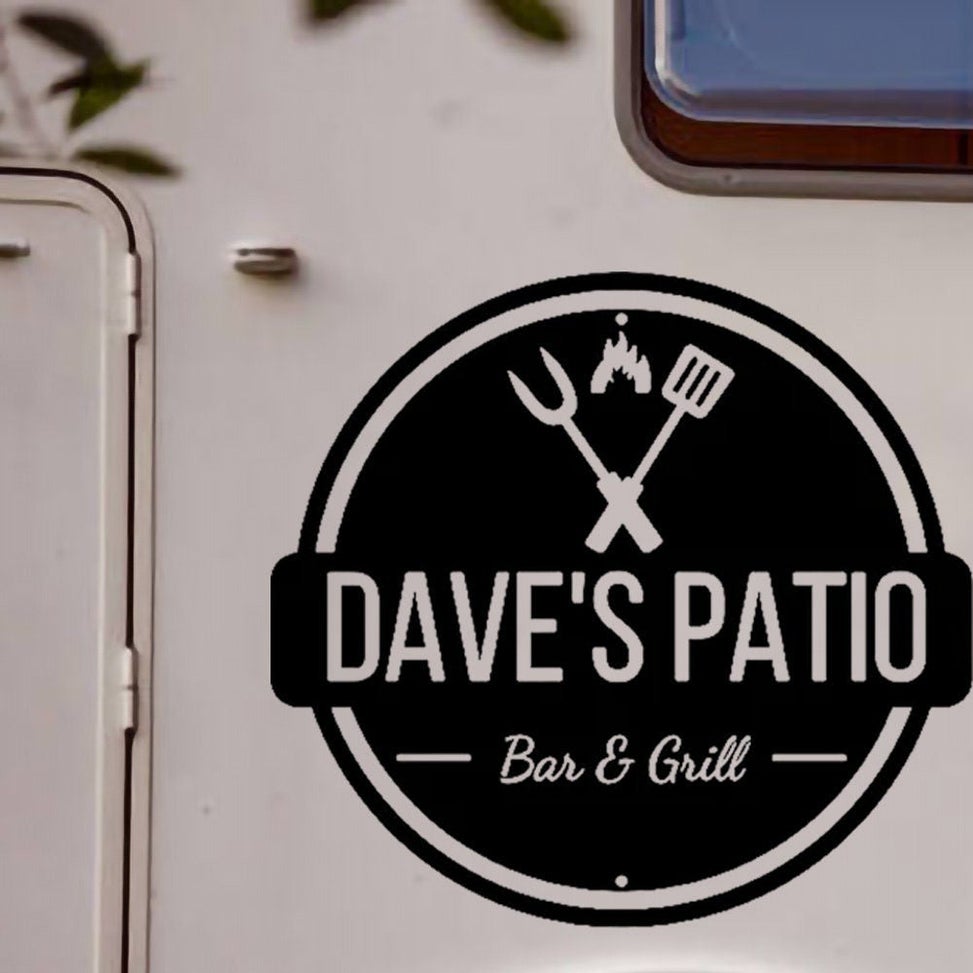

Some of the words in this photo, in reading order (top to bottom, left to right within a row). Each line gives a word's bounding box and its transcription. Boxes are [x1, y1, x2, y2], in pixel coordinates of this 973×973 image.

[326, 571, 645, 682] DAVE'S
[674, 570, 928, 682] PATIO
[500, 733, 585, 785] Bar
[595, 734, 635, 785] &
[648, 733, 752, 784] Grill
